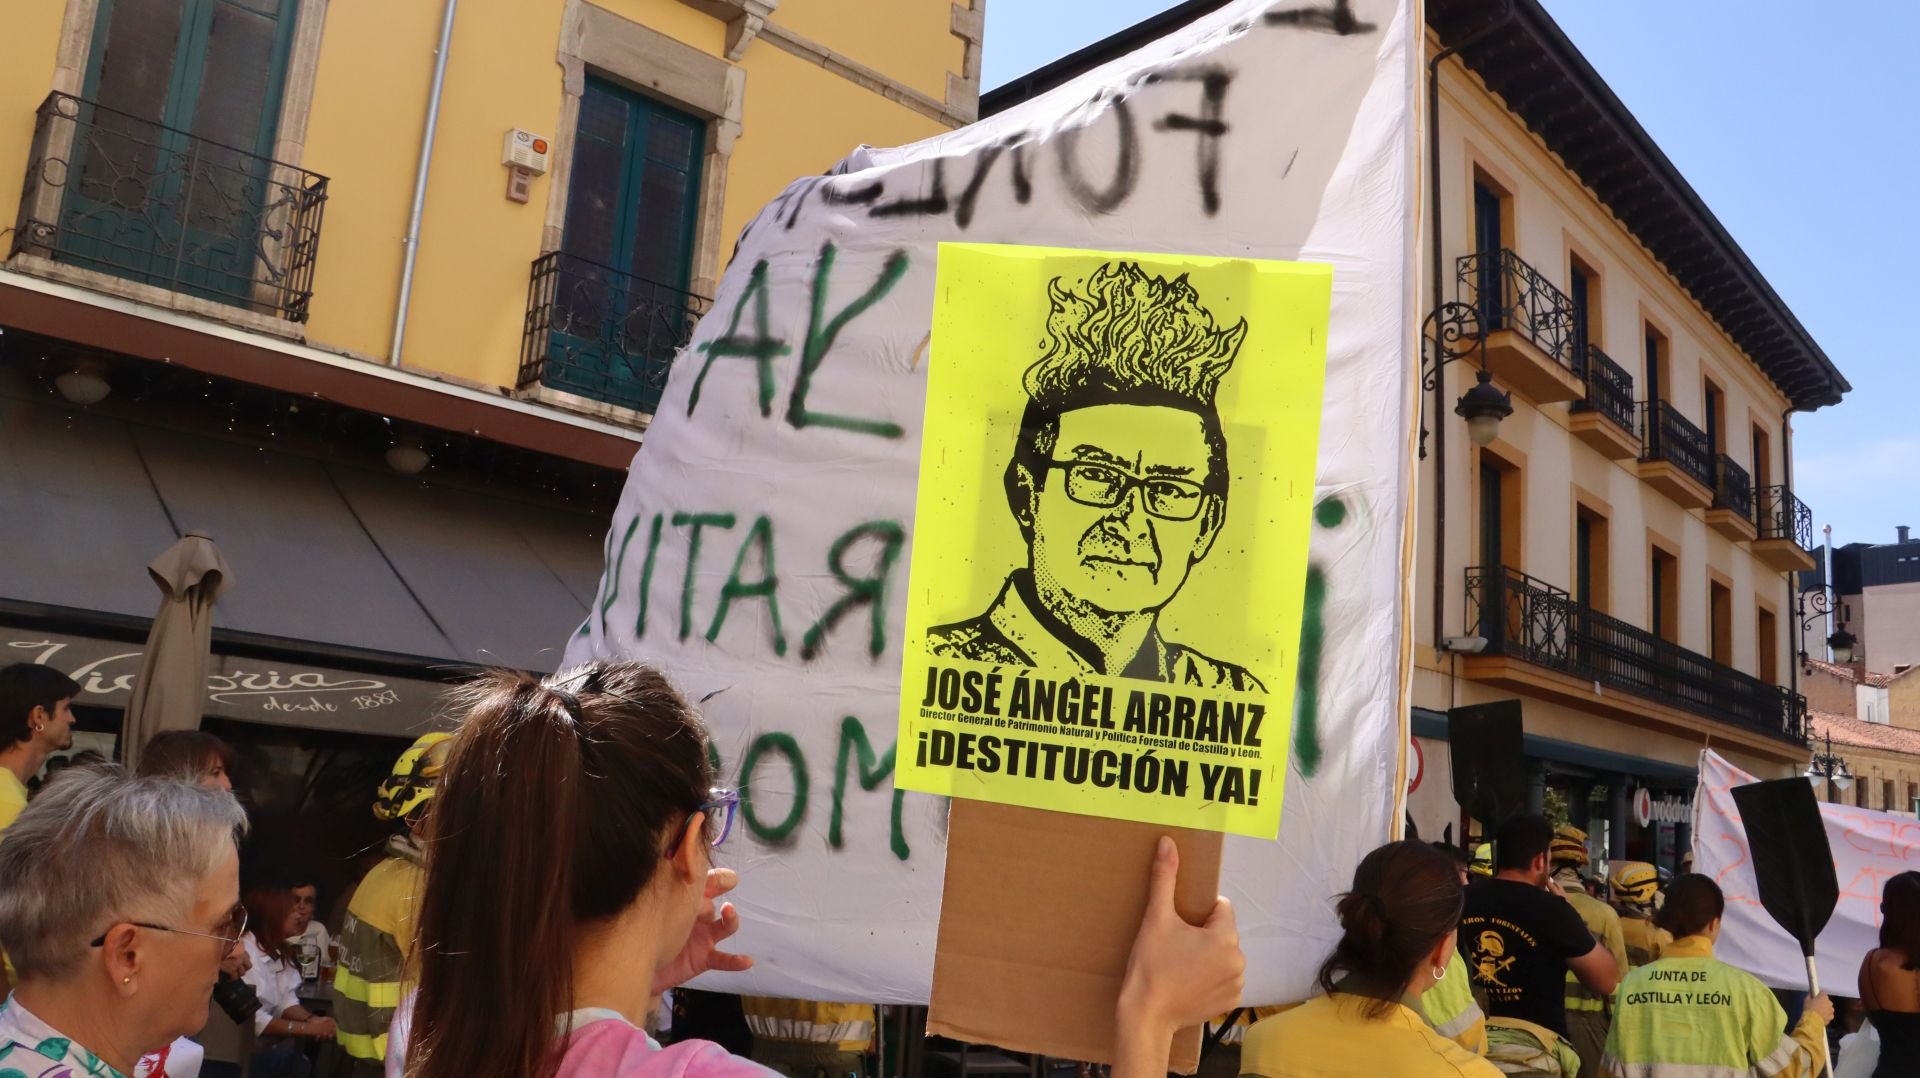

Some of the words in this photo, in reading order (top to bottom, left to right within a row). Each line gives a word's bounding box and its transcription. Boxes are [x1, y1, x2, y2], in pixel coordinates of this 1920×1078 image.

[263, 696, 338, 712] desde
[352, 690, 400, 710] 1887
[922, 666, 1003, 715] JOSÉ
[1008, 669, 1116, 729] ÁNGEL
[1123, 689, 1266, 748] ARRANZ
[920, 708, 956, 722] Director
[957, 712, 993, 727] General
[995, 717, 1006, 728] de
[1008, 719, 1057, 735] Patrimonio
[1059, 726, 1094, 739] Natural
[1095, 731, 1101, 741] y
[1138, 735, 1177, 750] Forestal
[1178, 740, 1190, 752] de
[1192, 741, 1229, 756] Castilla
[1230, 749, 1236, 758] y
[916, 729, 1190, 798] ¡DESTITUCIÓN
[1199, 763, 1262, 806] YA!
[1651, 795, 1694, 823] vodafon
[1491, 916, 1537, 947] FORESTALES
[1649, 970, 1688, 982] JUNTA
[1691, 971, 1707, 982] DE
[1626, 991, 1682, 1005] CASTILLA
[1685, 993, 1693, 1004] Y
[1696, 990, 1731, 1006] LEÓN
